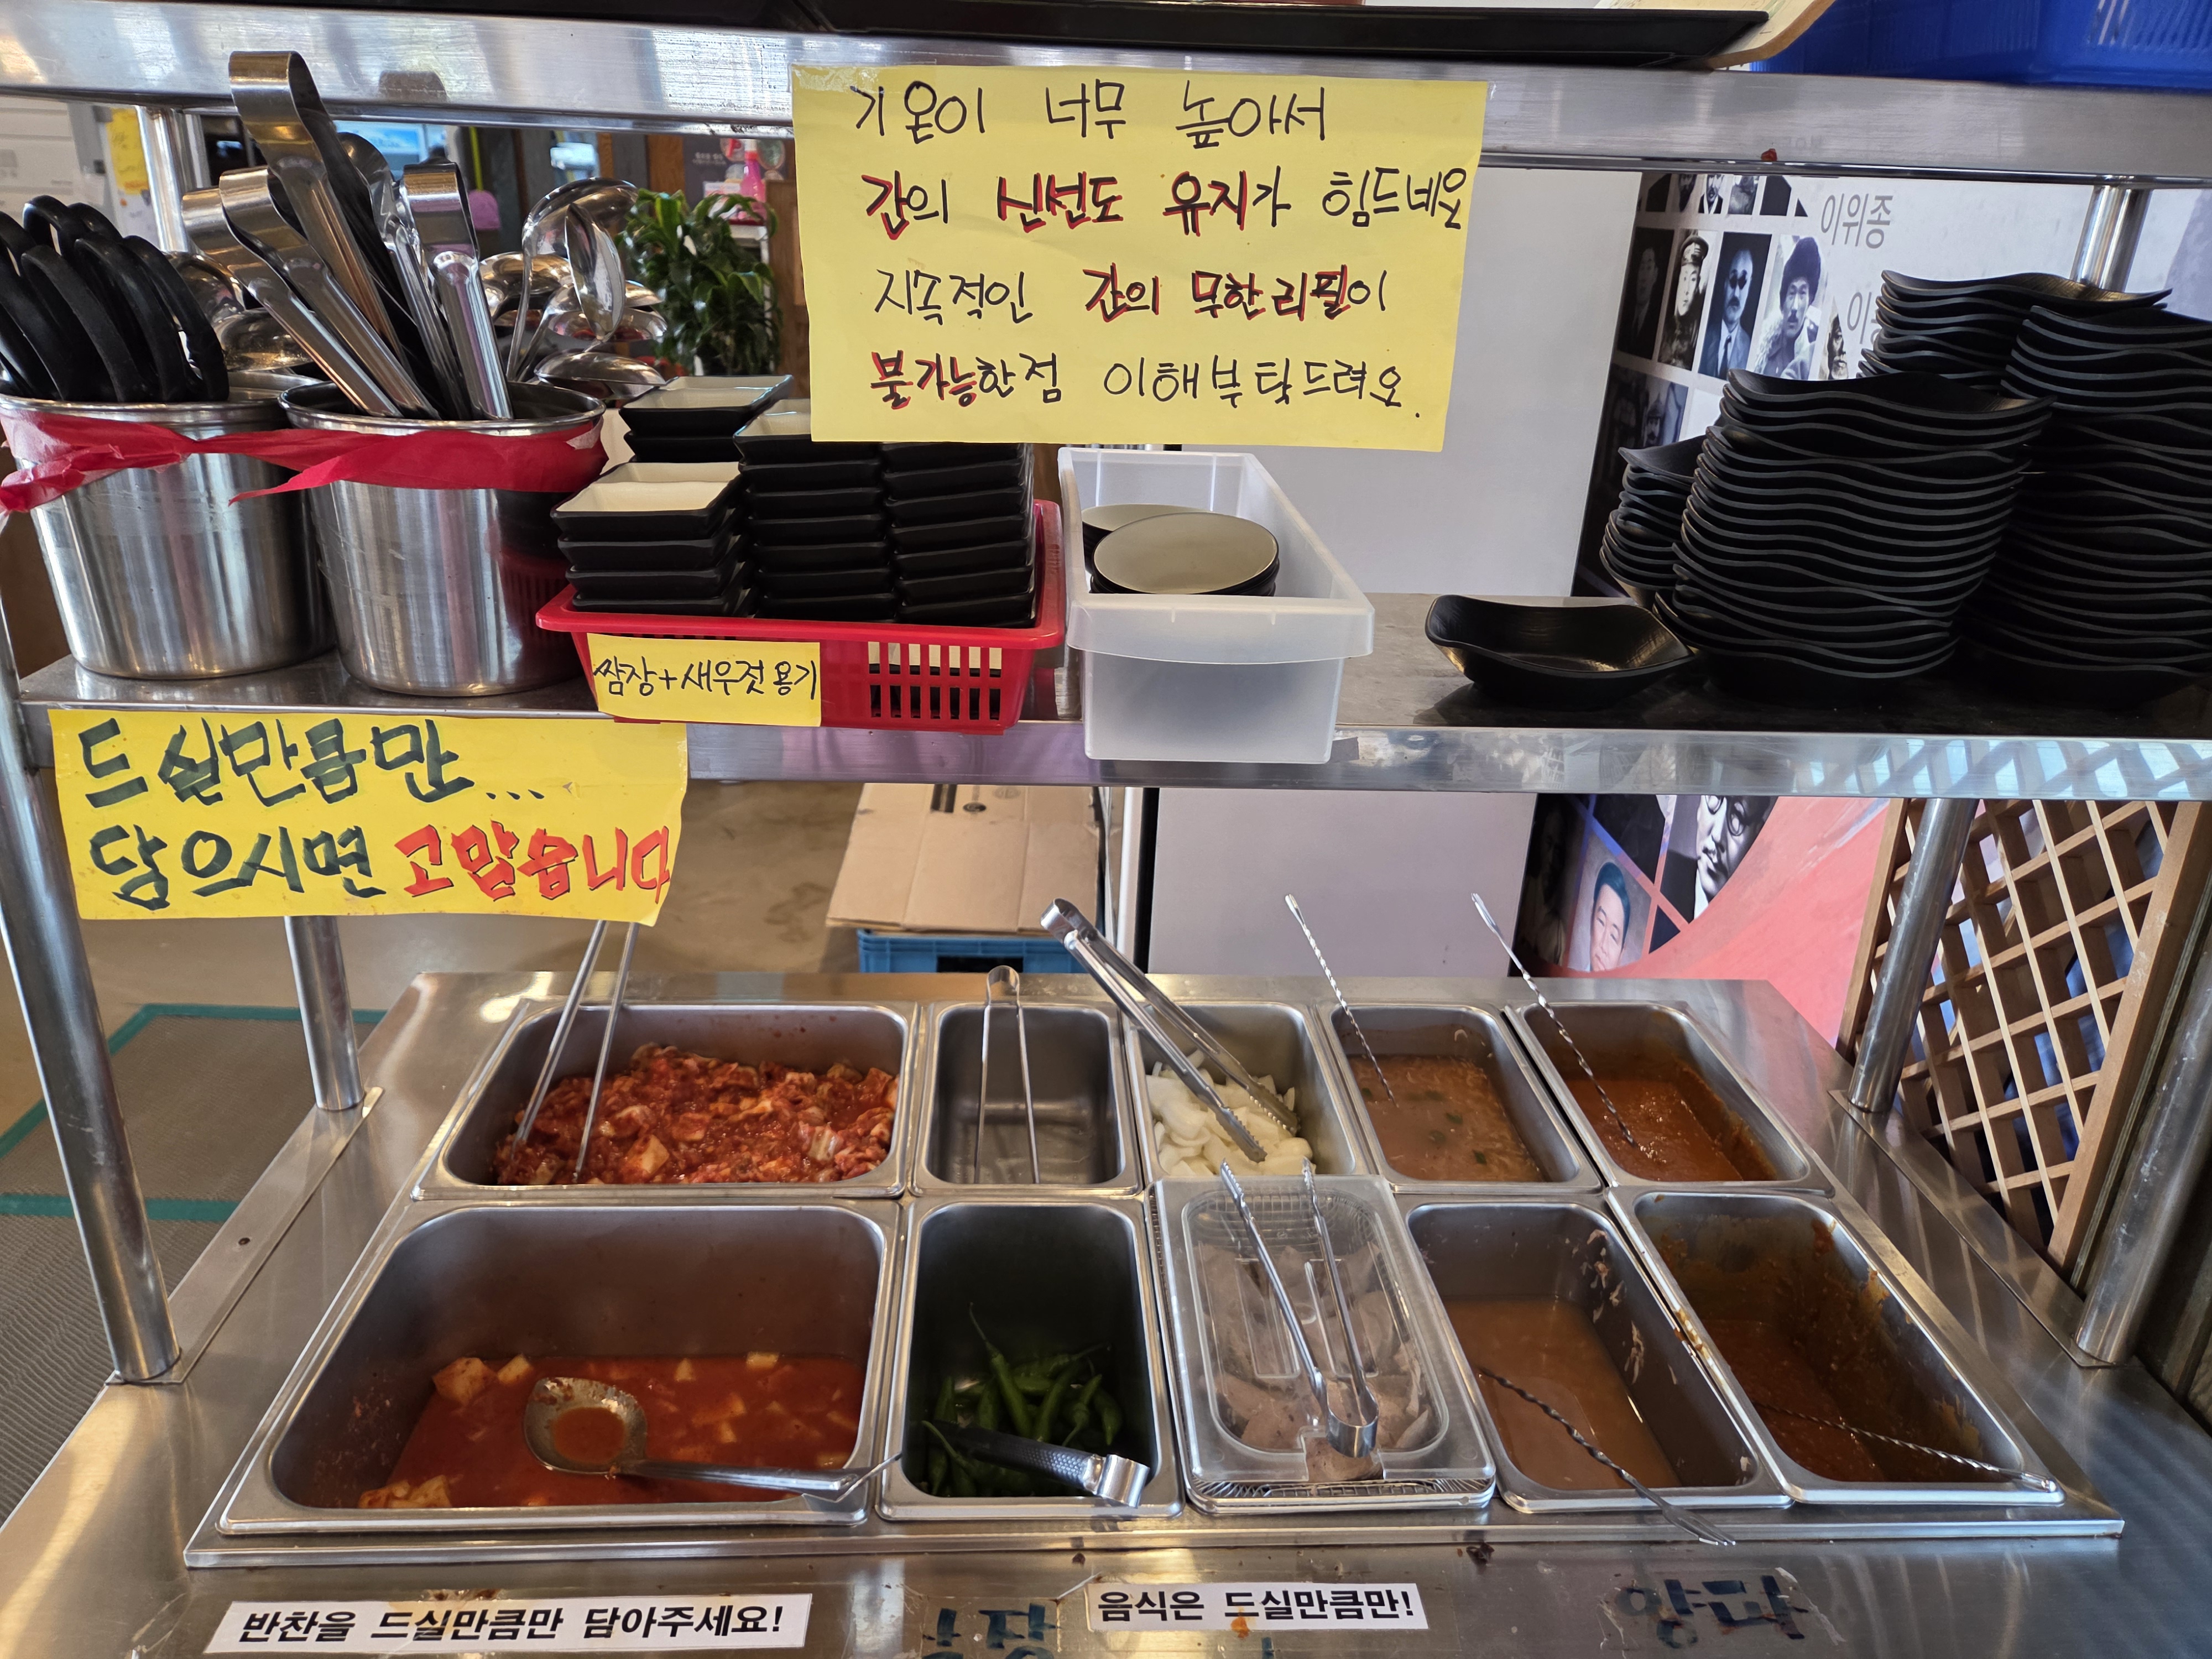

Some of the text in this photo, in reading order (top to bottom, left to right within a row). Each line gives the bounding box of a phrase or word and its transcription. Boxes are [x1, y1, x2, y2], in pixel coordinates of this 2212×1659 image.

[850, 79, 1325, 149] 기온이 너무 높아서
[862, 170, 948, 240] 간의
[998, 171, 1124, 233] 신선도
[1162, 165, 1292, 237] 유지가
[1821, 193, 1893, 249] 이위종
[874, 269, 1033, 326] 지속적인
[1083, 262, 1159, 322] 간의
[394, 820, 671, 904] 고맙습니다
[239, 1605, 783, 1642] 반찬을 드실만큼만 담아주세요!
[1098, 1589, 1413, 1621] 음식은 드실만큼만!
